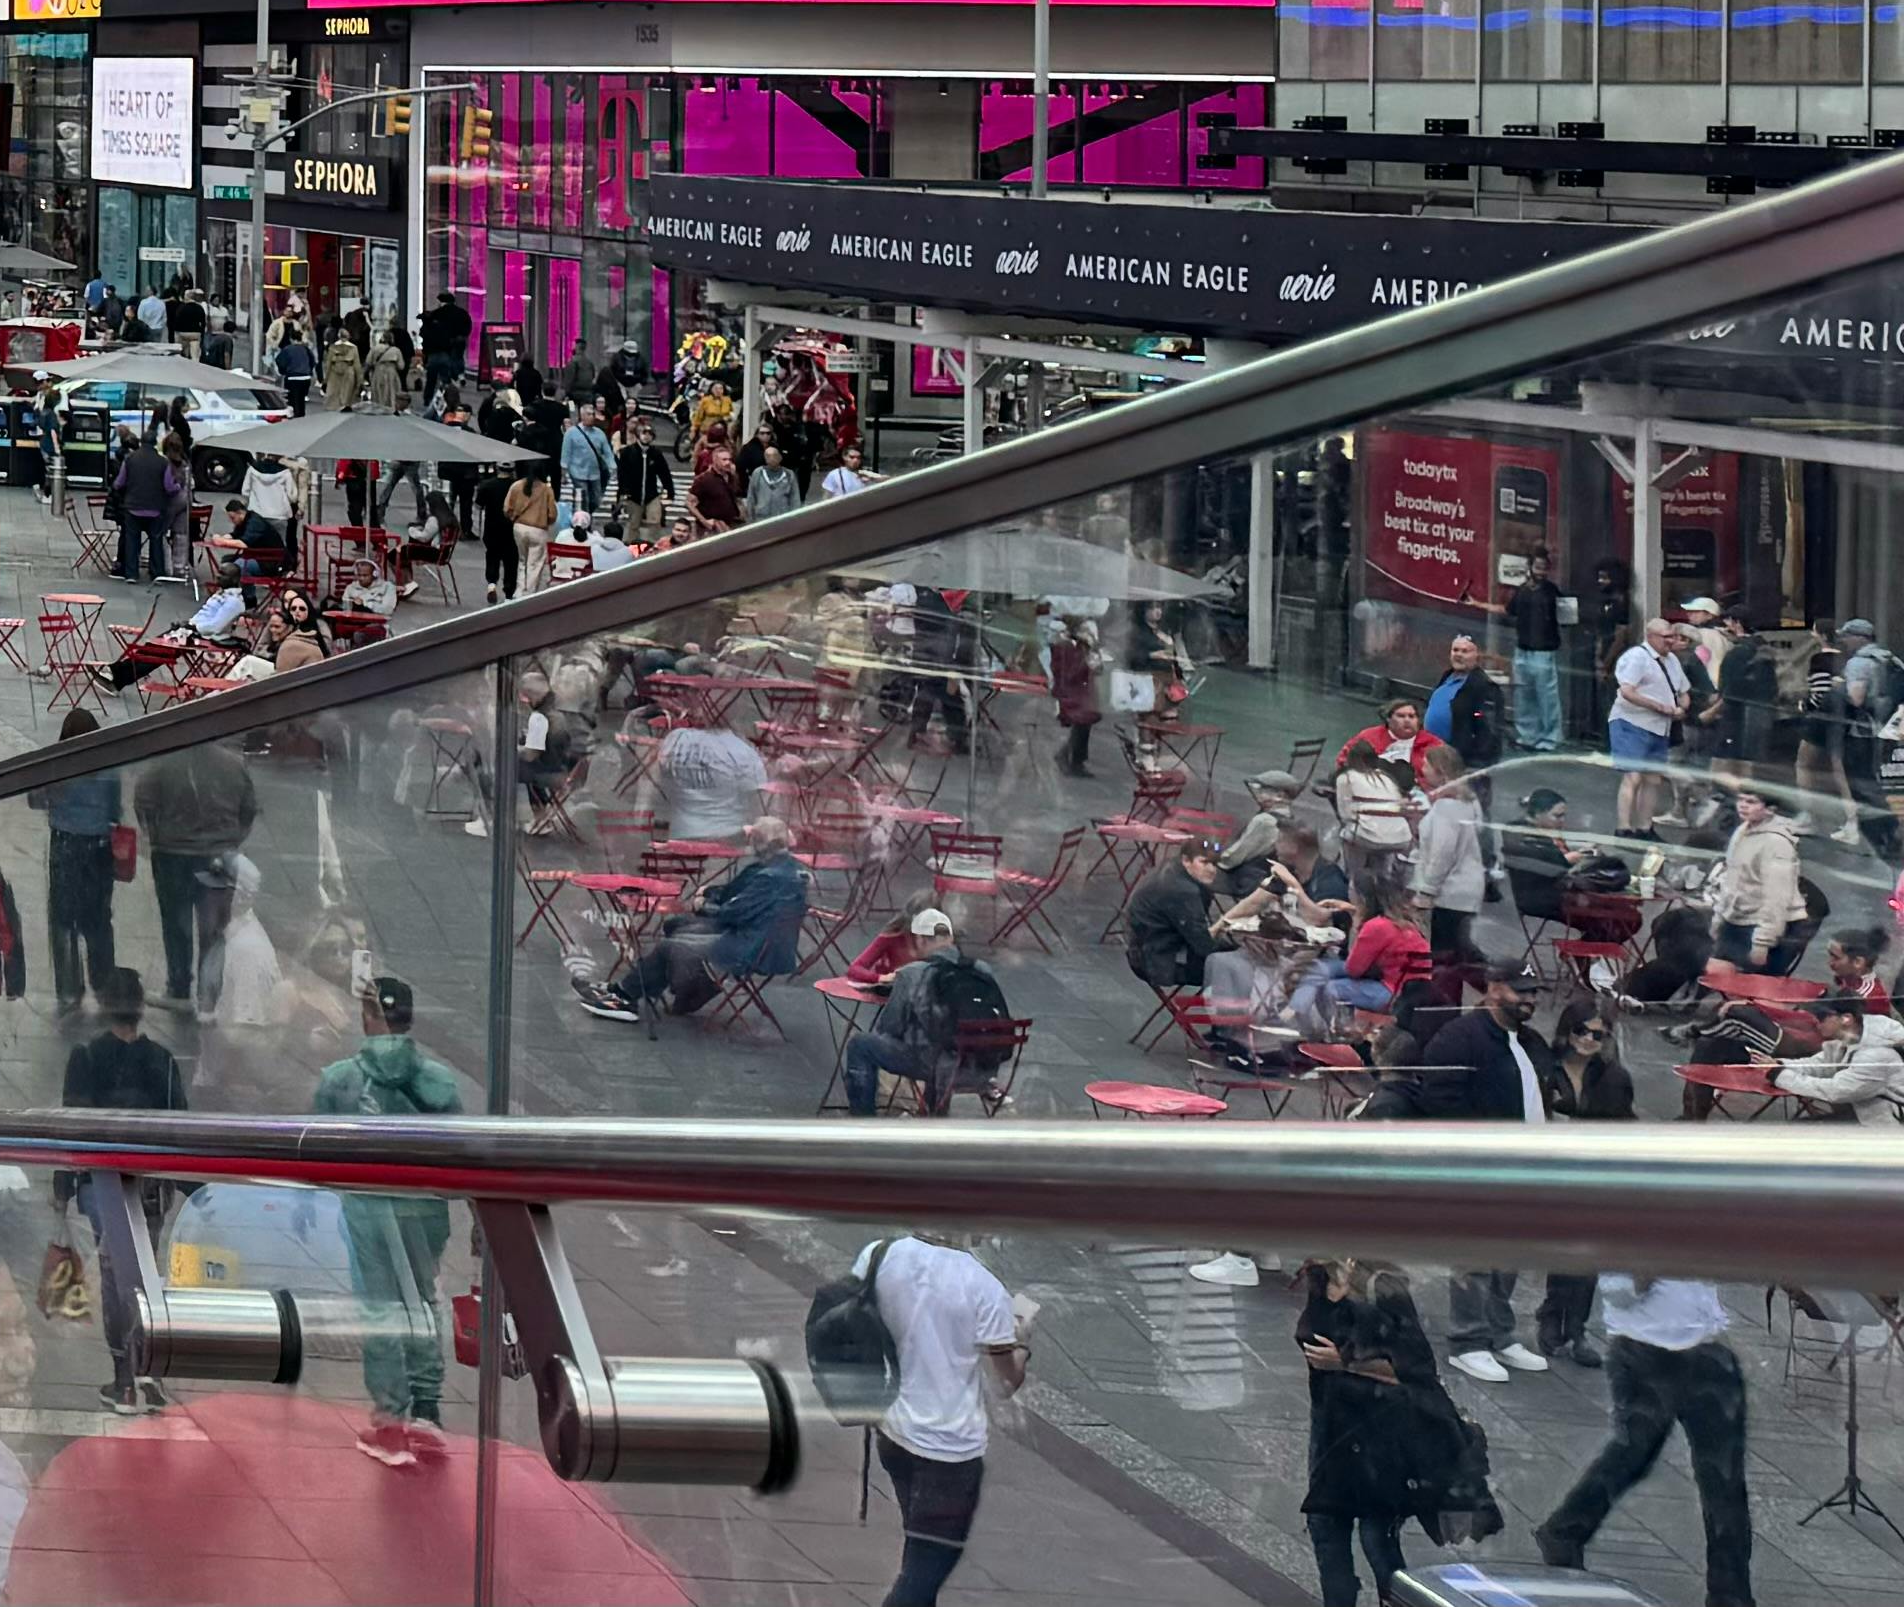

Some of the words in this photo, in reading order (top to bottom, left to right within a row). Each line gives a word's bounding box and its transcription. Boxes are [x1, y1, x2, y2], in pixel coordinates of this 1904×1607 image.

[324, 18, 370, 35] SEPHORA
[634, 25, 658, 43] 1535
[108, 89, 151, 118] HEART
[154, 90, 175, 116] OF
[101, 130, 135, 158] TIMES
[137, 132, 181, 159] SQUARE
[293, 160, 378, 195] SEPHORA
[647, 216, 714, 246] AMERICAN
[719, 221, 762, 249] EAGLE
[776, 223, 811, 256] aerie
[831, 232, 913, 262] AMERICAN
[918, 237, 973, 267] EAGLE
[996, 241, 1039, 280] aerie
[1066, 252, 1173, 288] AMERICAN
[1182, 259, 1249, 294] EAGLE
[1279, 261, 1335, 303] aerie
[1403, 459, 1458, 482] todaytix
[1395, 490, 1466, 519] Broadway's
[1384, 513, 1411, 533] best
[1413, 516, 1428, 535] tix
[1432, 520, 1445, 537] at
[1448, 522, 1475, 544] your
[1397, 537, 1461, 564] fingertips.
